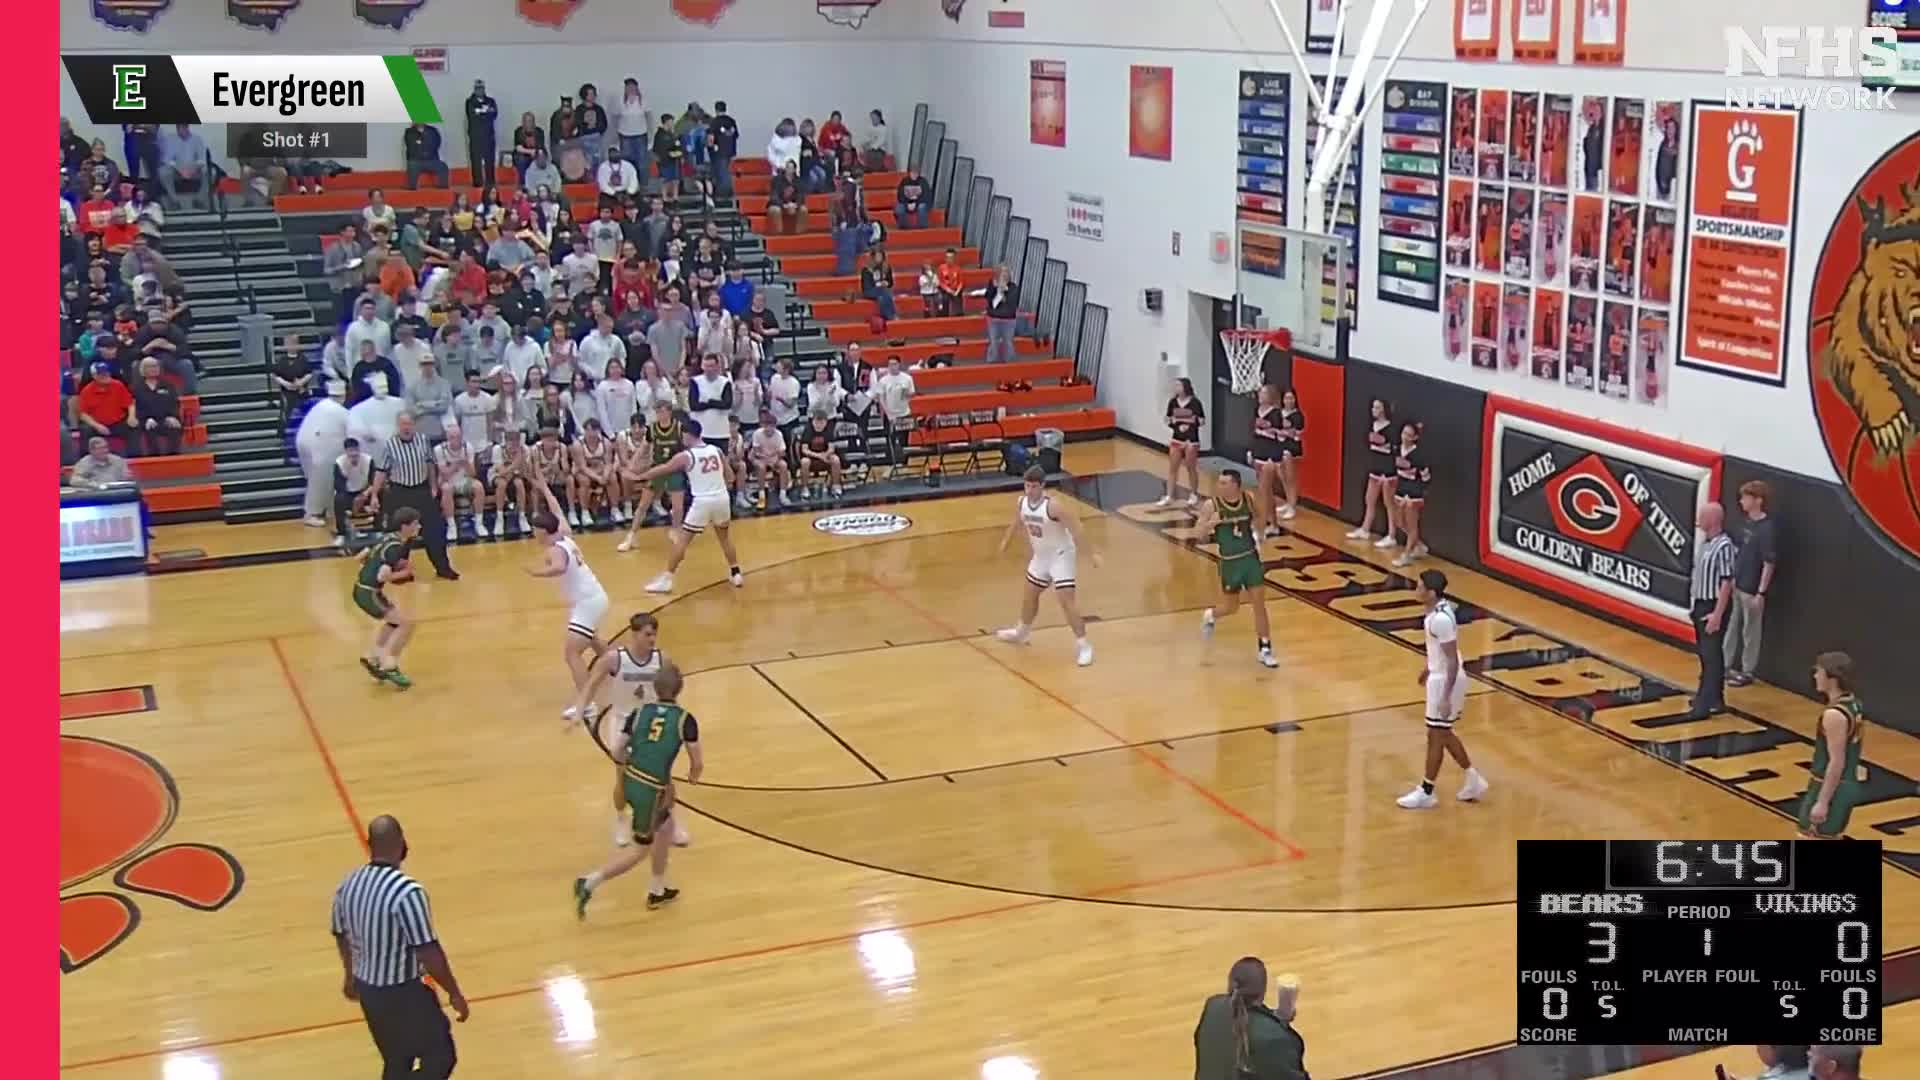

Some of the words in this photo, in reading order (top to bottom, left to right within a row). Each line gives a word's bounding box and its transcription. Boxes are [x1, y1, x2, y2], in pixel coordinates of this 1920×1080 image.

[1696, 218, 1785, 242] SPORTSMANSHIP
[699, 455, 719, 474] 23
[1508, 451, 1556, 497] HOME
[1558, 473, 1621, 535] G
[1623, 472, 1649, 504] OF
[1647, 503, 1687, 556] THE
[1516, 526, 1583, 567] GOLDEN
[1591, 552, 1651, 591] BEARS
[648, 717, 665, 742] 5
